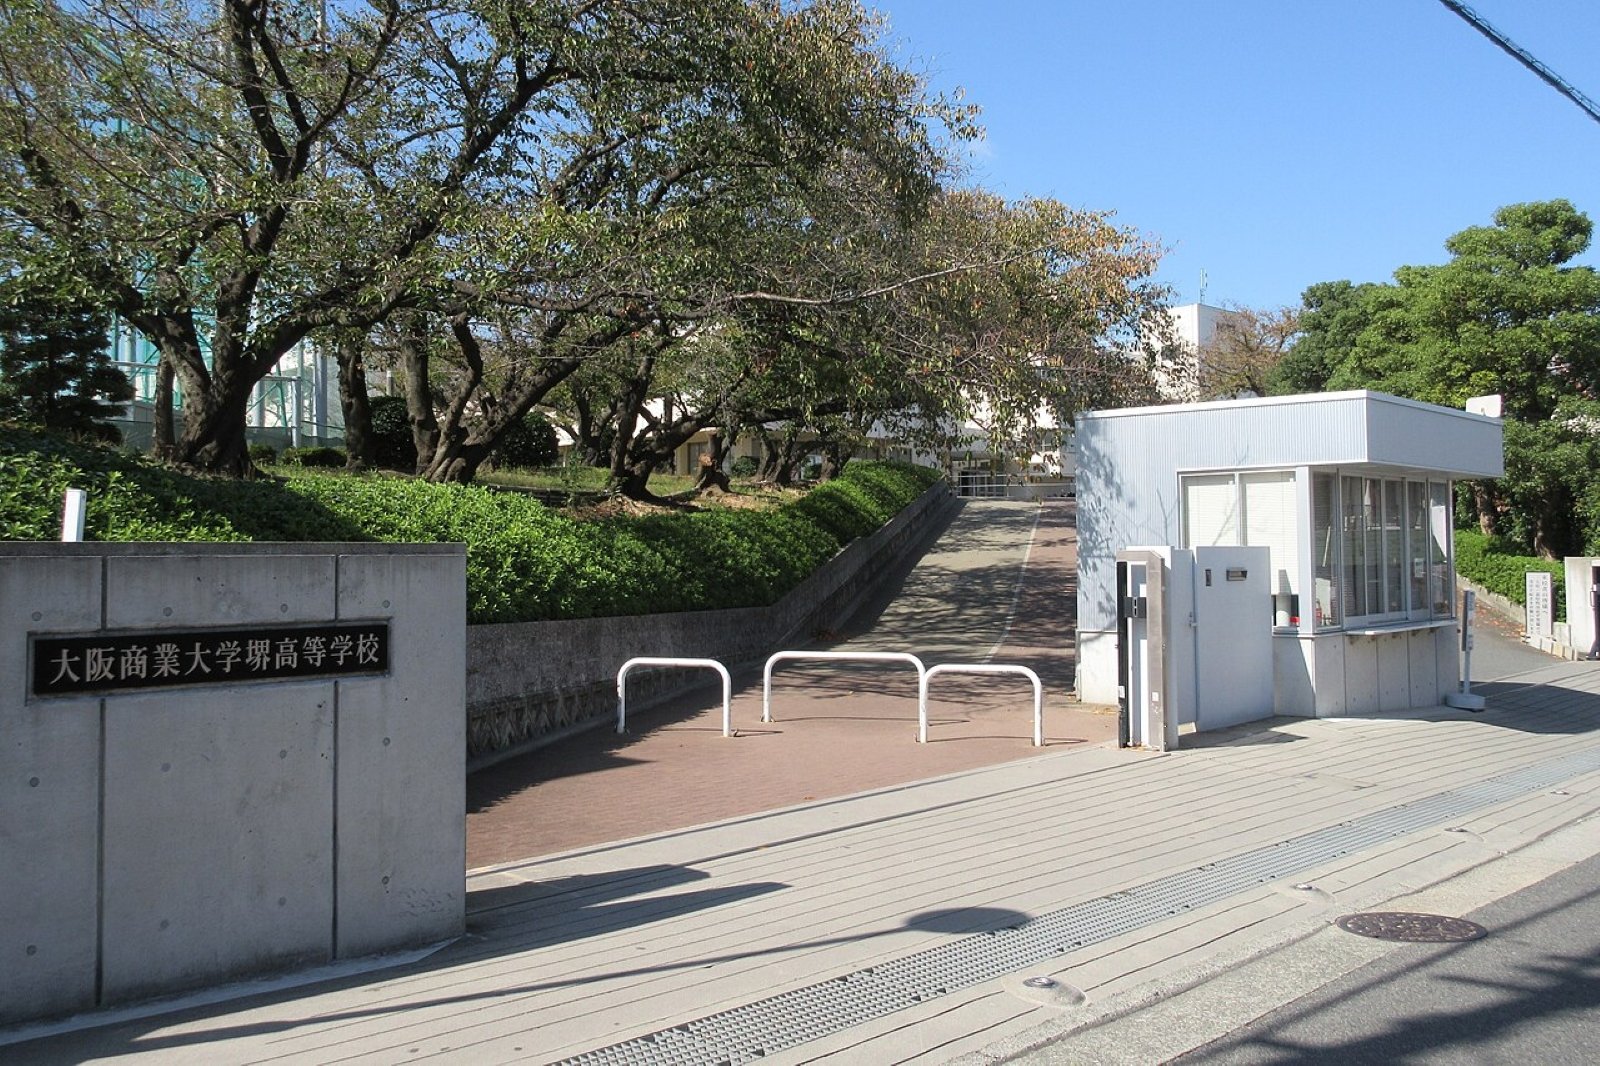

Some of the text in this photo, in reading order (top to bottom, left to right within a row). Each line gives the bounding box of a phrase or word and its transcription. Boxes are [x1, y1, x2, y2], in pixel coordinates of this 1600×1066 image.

[50, 633, 380, 685] 大阪商業大学堺高等学校
